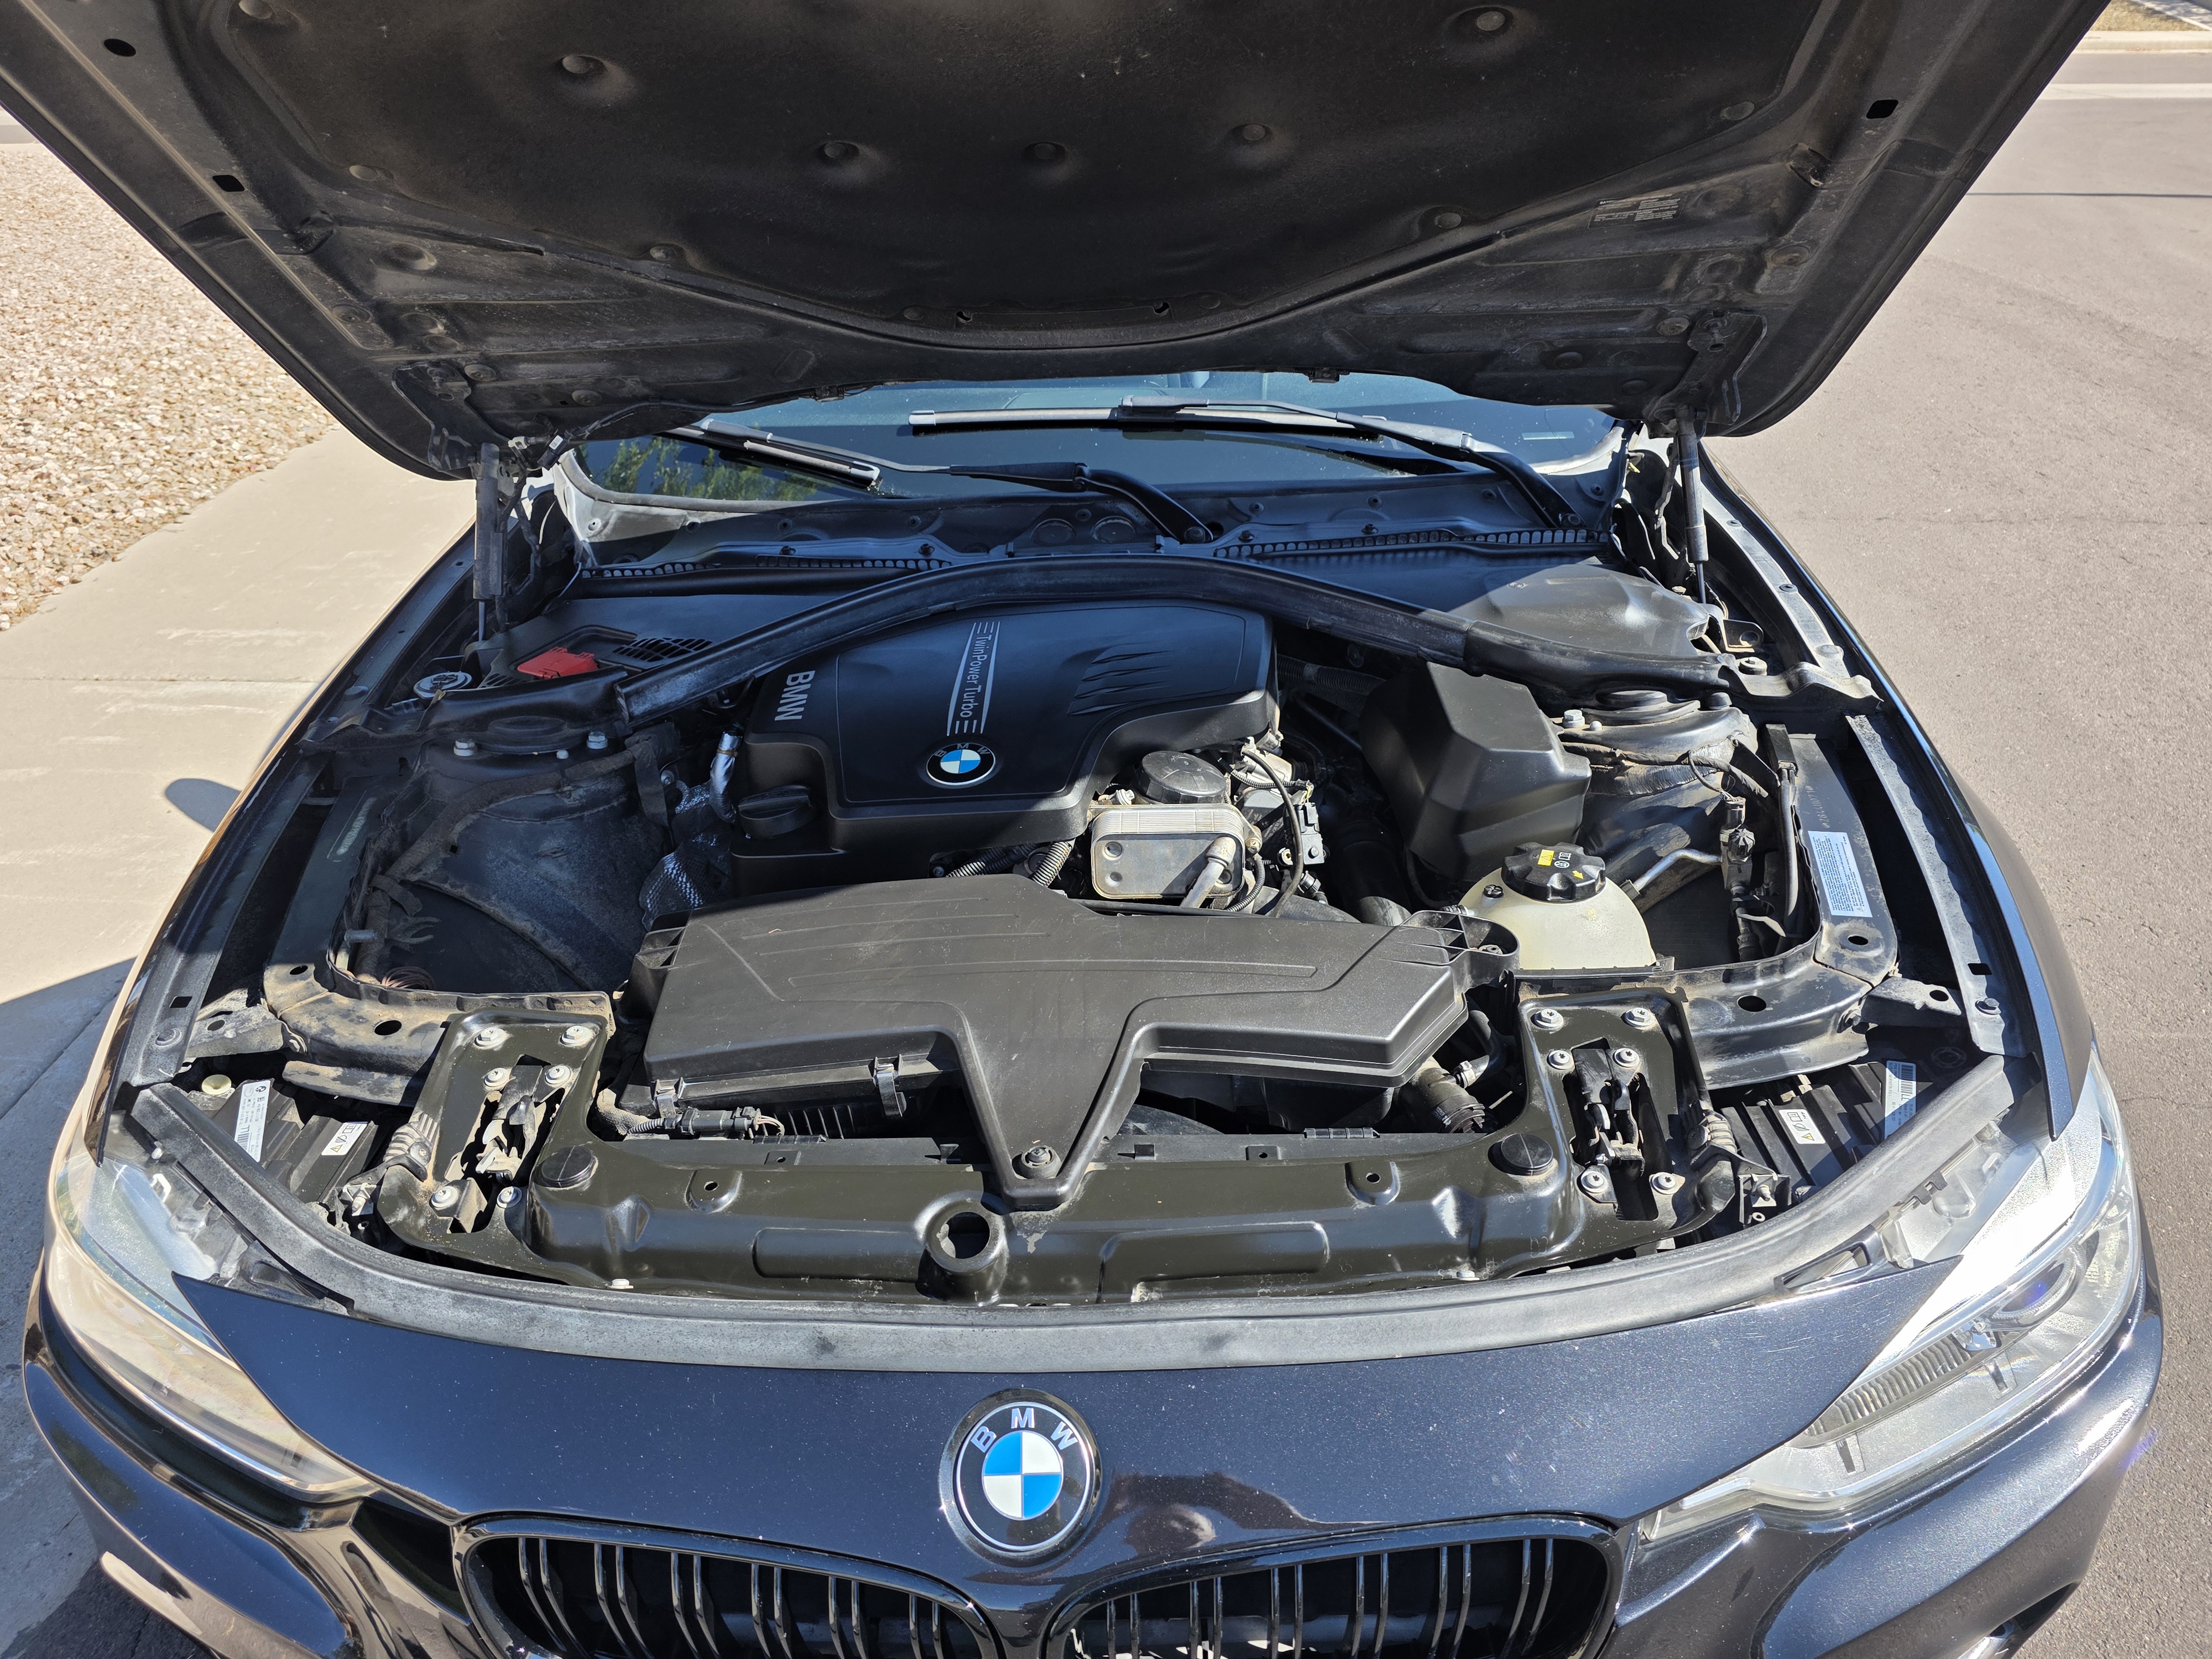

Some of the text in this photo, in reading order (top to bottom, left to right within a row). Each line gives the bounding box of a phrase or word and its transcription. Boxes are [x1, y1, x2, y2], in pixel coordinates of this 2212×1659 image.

[774, 670, 816, 721] BMW
[959, 634, 992, 718] TwinPower Turbo
[934, 743, 990, 758] BMW
[971, 1407, 1078, 1453] BMW
